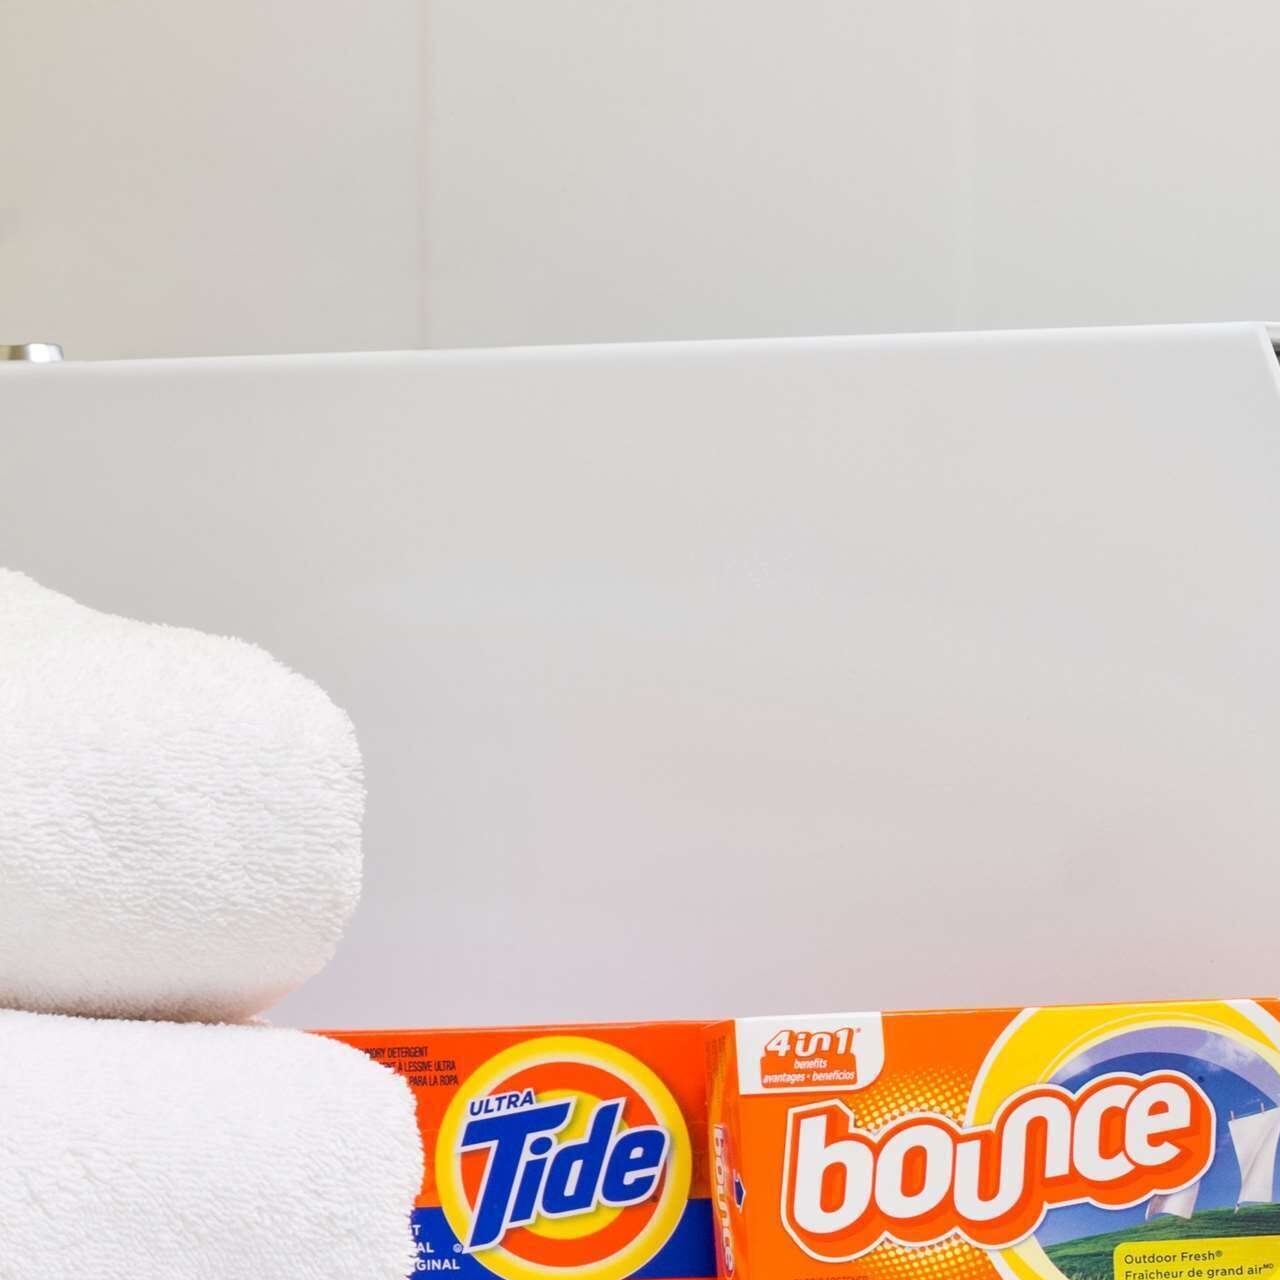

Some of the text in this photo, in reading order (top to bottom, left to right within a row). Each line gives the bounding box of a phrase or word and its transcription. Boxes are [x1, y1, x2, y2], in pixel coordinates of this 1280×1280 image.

[387, 1045, 429, 1058] DETERGENT
[434, 1060, 456, 1072] ULTRA
[794, 1058, 827, 1069] benefits
[429, 1075, 438, 1086] LA
[439, 1074, 459, 1086] ROPA
[763, 1073, 805, 1085] avantages
[469, 1090, 534, 1116] ULTRA
[788, 1072, 1200, 1240] bounce
[459, 1097, 668, 1252] Tide
[416, 1258, 461, 1271] GINAL
[1124, 1252, 1177, 1265] Outdoor
[1187, 1267, 1203, 1278] de
[1207, 1265, 1243, 1279] grand
